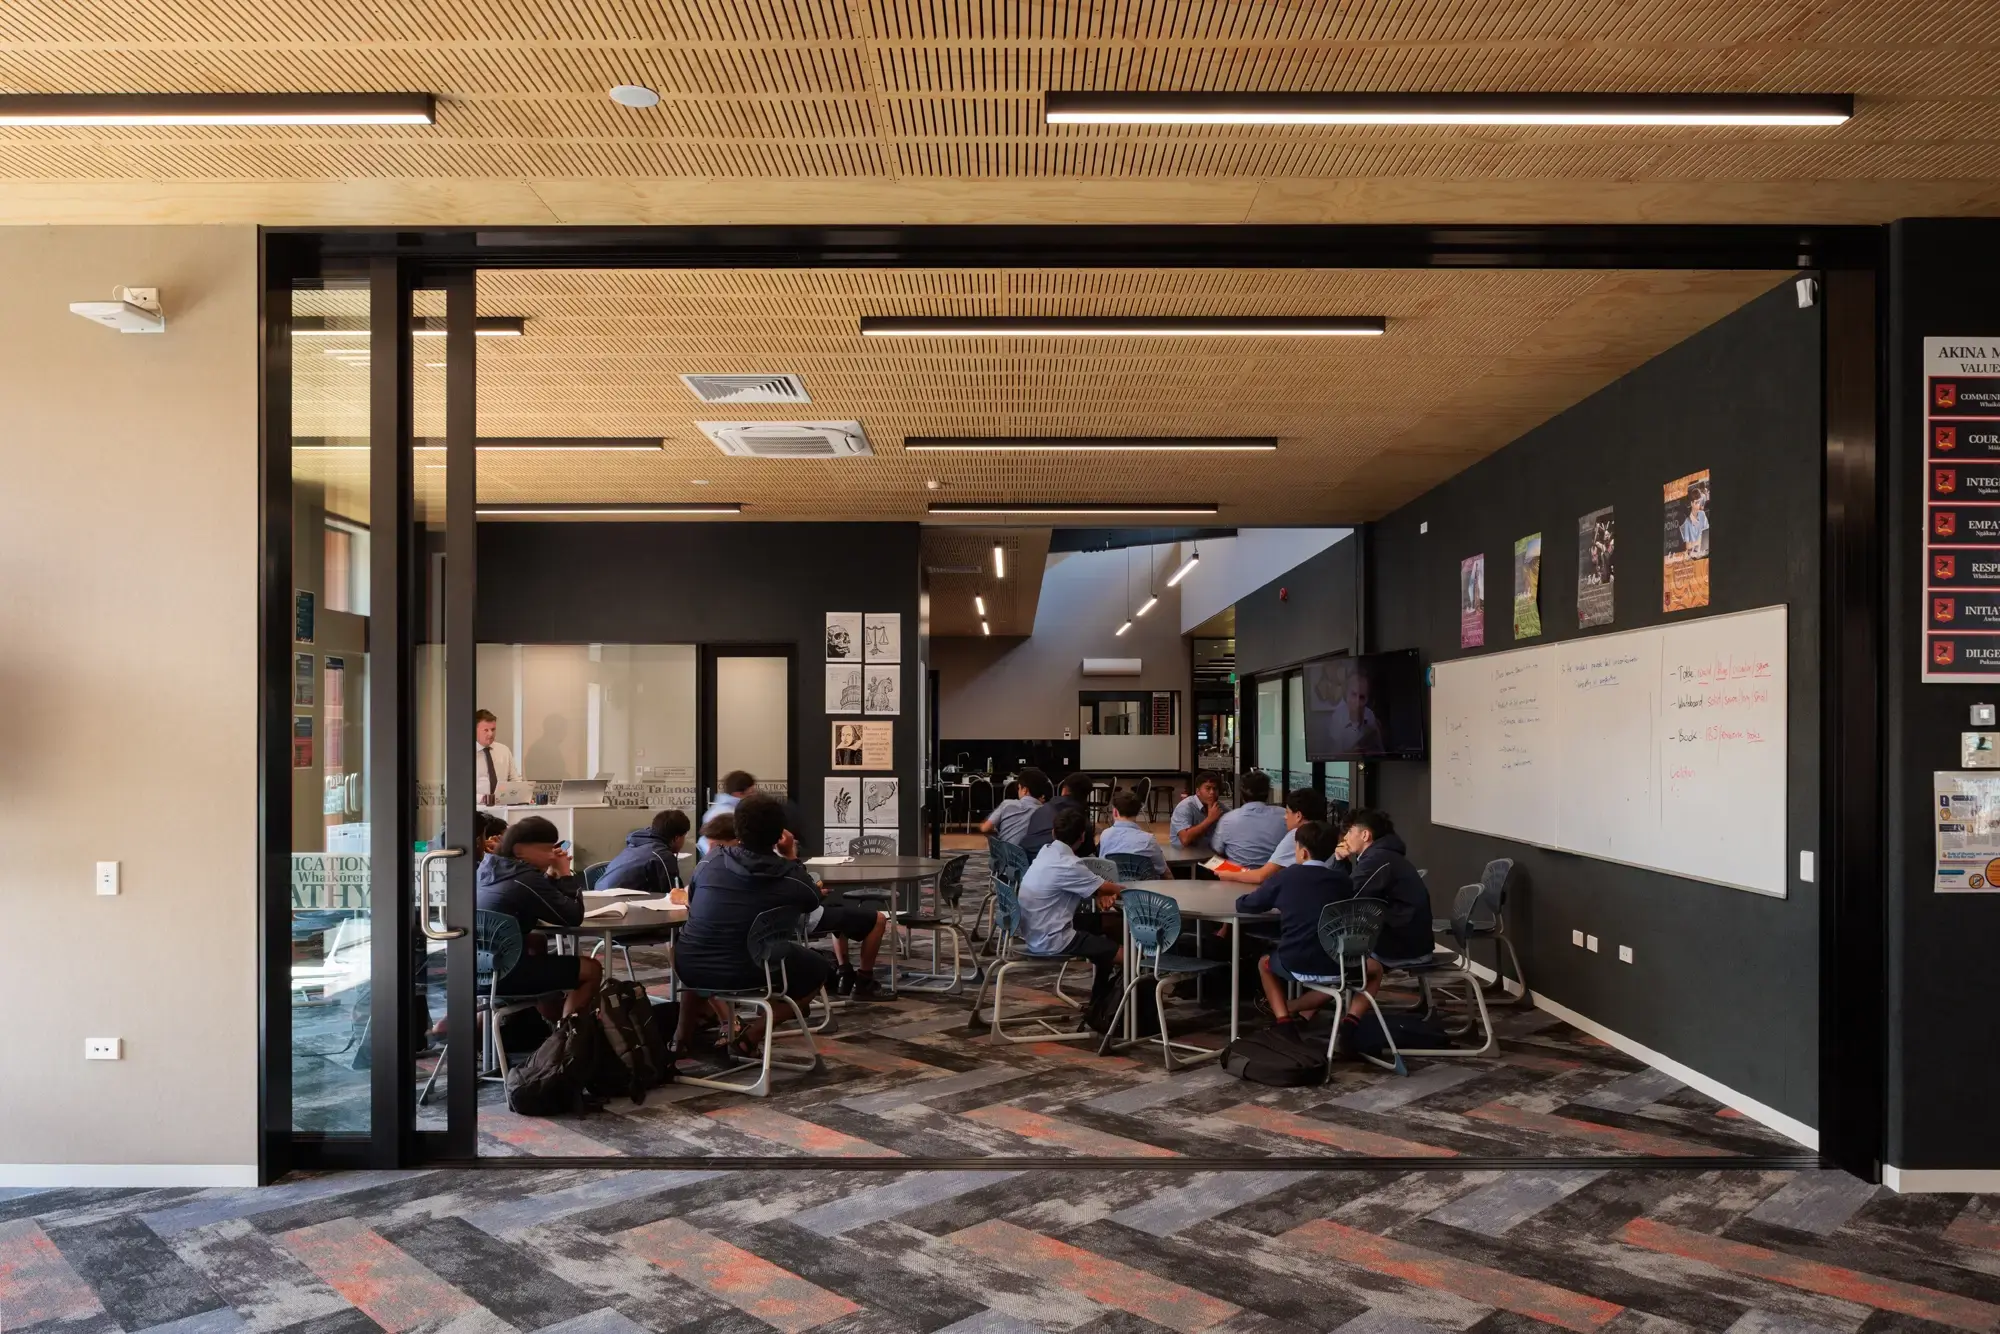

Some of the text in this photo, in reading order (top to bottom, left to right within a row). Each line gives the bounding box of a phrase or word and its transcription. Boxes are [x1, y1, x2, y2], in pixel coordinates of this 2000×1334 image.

[1938, 346, 1987, 359] AKINA
[1968, 434, 2000, 444] COUR
[1968, 520, 2000, 530] EMPA
[1964, 605, 2000, 616] INITIA
[645, 796, 697, 806] COURAGE
[292, 857, 371, 871] ICATION
